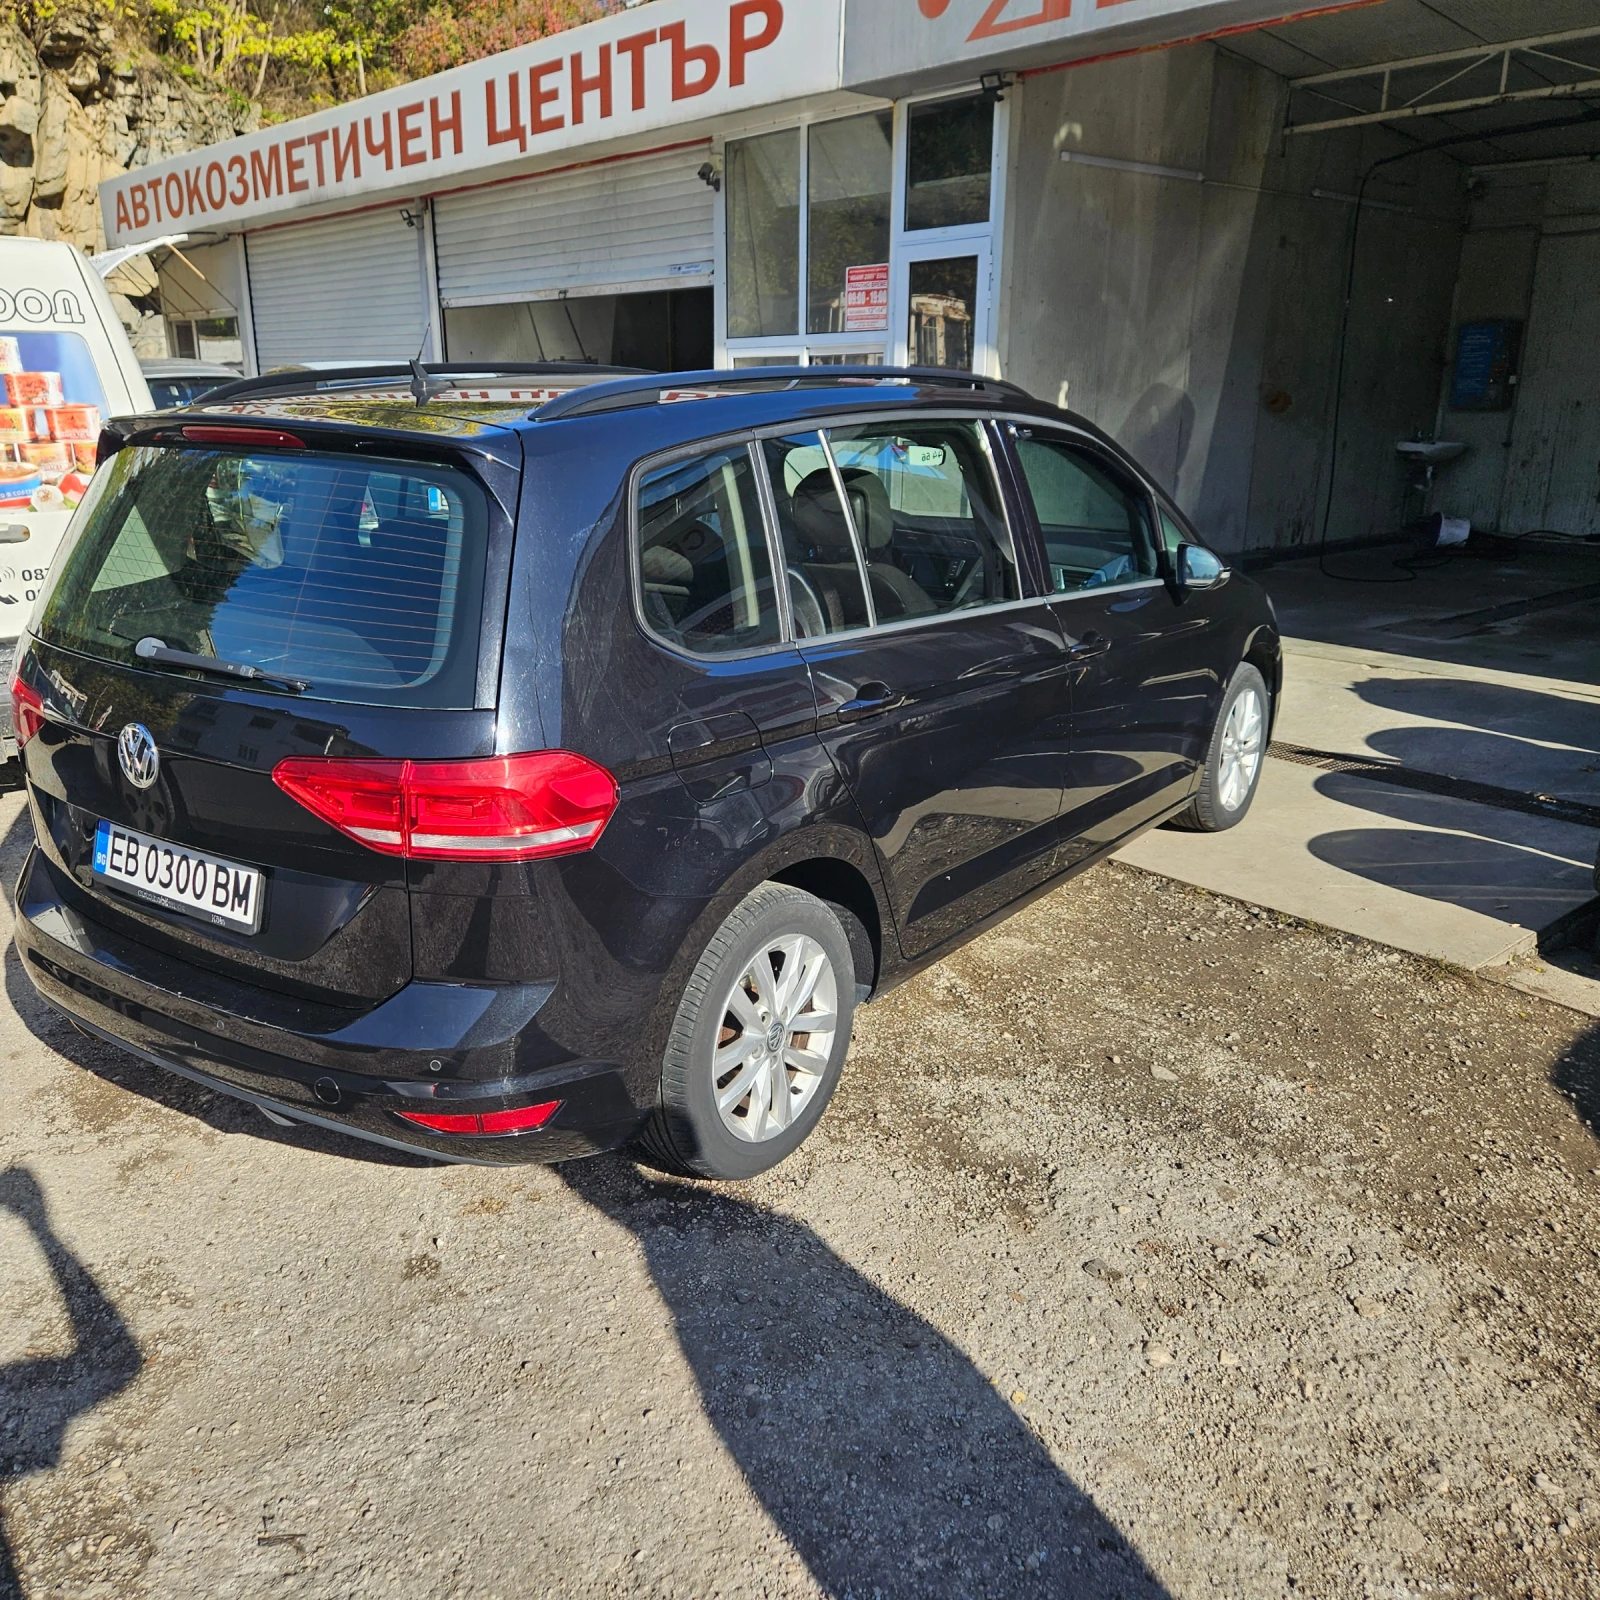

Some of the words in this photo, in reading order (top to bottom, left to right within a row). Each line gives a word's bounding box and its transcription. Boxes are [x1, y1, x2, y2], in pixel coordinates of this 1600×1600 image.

[116, 90, 462, 234] АВТОКОЗМЕТИЧЕН
[486, 0, 783, 152] ЦЕНТЪР
[96, 852, 107, 866] BG
